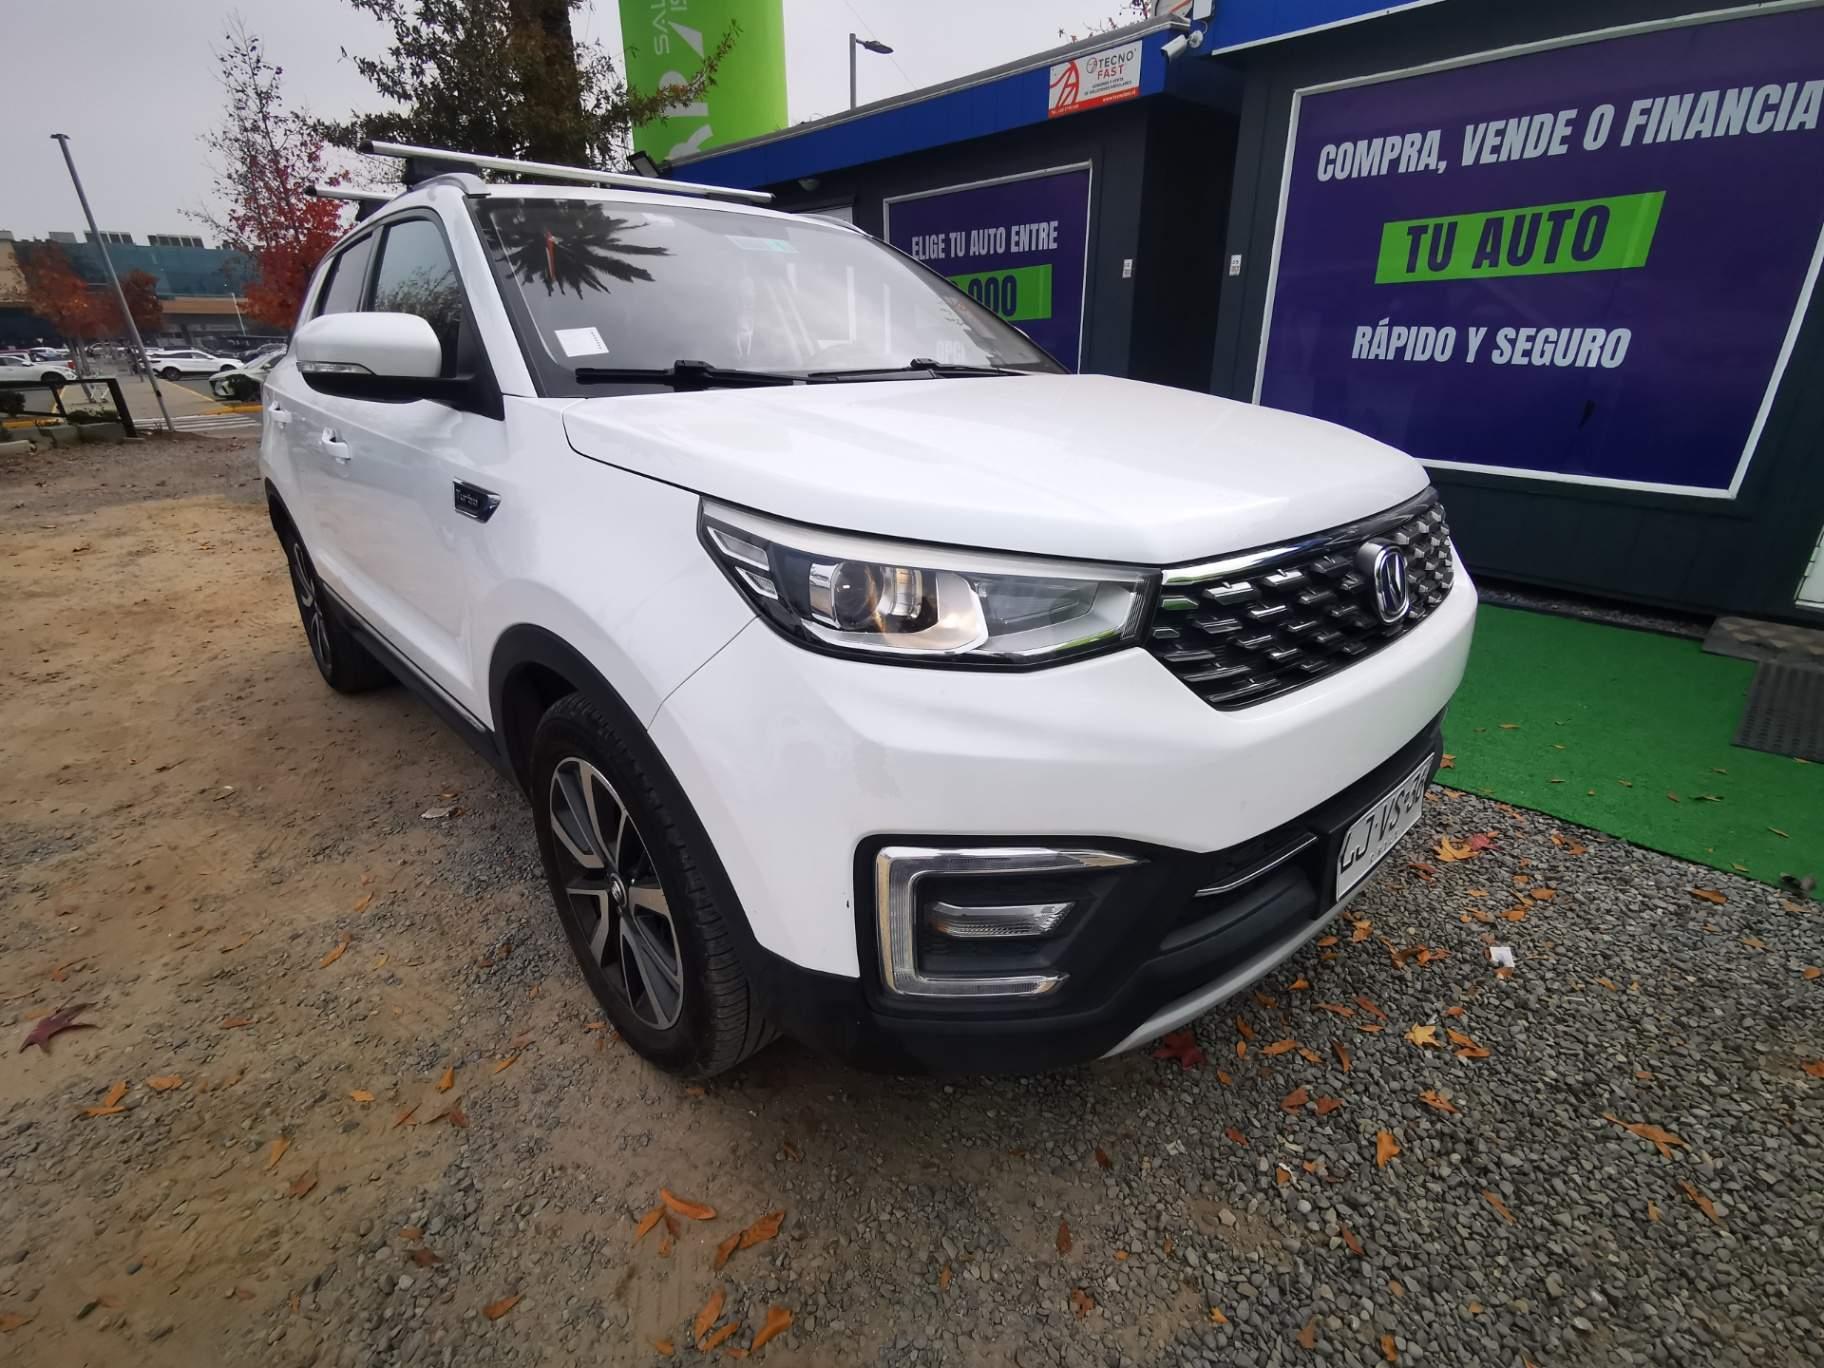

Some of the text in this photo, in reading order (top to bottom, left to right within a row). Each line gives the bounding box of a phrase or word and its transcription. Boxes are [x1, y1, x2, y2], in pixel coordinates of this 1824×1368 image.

[1097, 65, 1124, 80] FAST
[1098, 51, 1134, 69] TECNO
[1317, 79, 1824, 182] COMPRA, VENDE O FINANCIA
[912, 220, 1058, 261] ELIGE TU AUTO ENTRE
[1405, 205, 1611, 274] TU AUTO
[1352, 317, 1631, 369] RÁPIDO Y SEGURO
